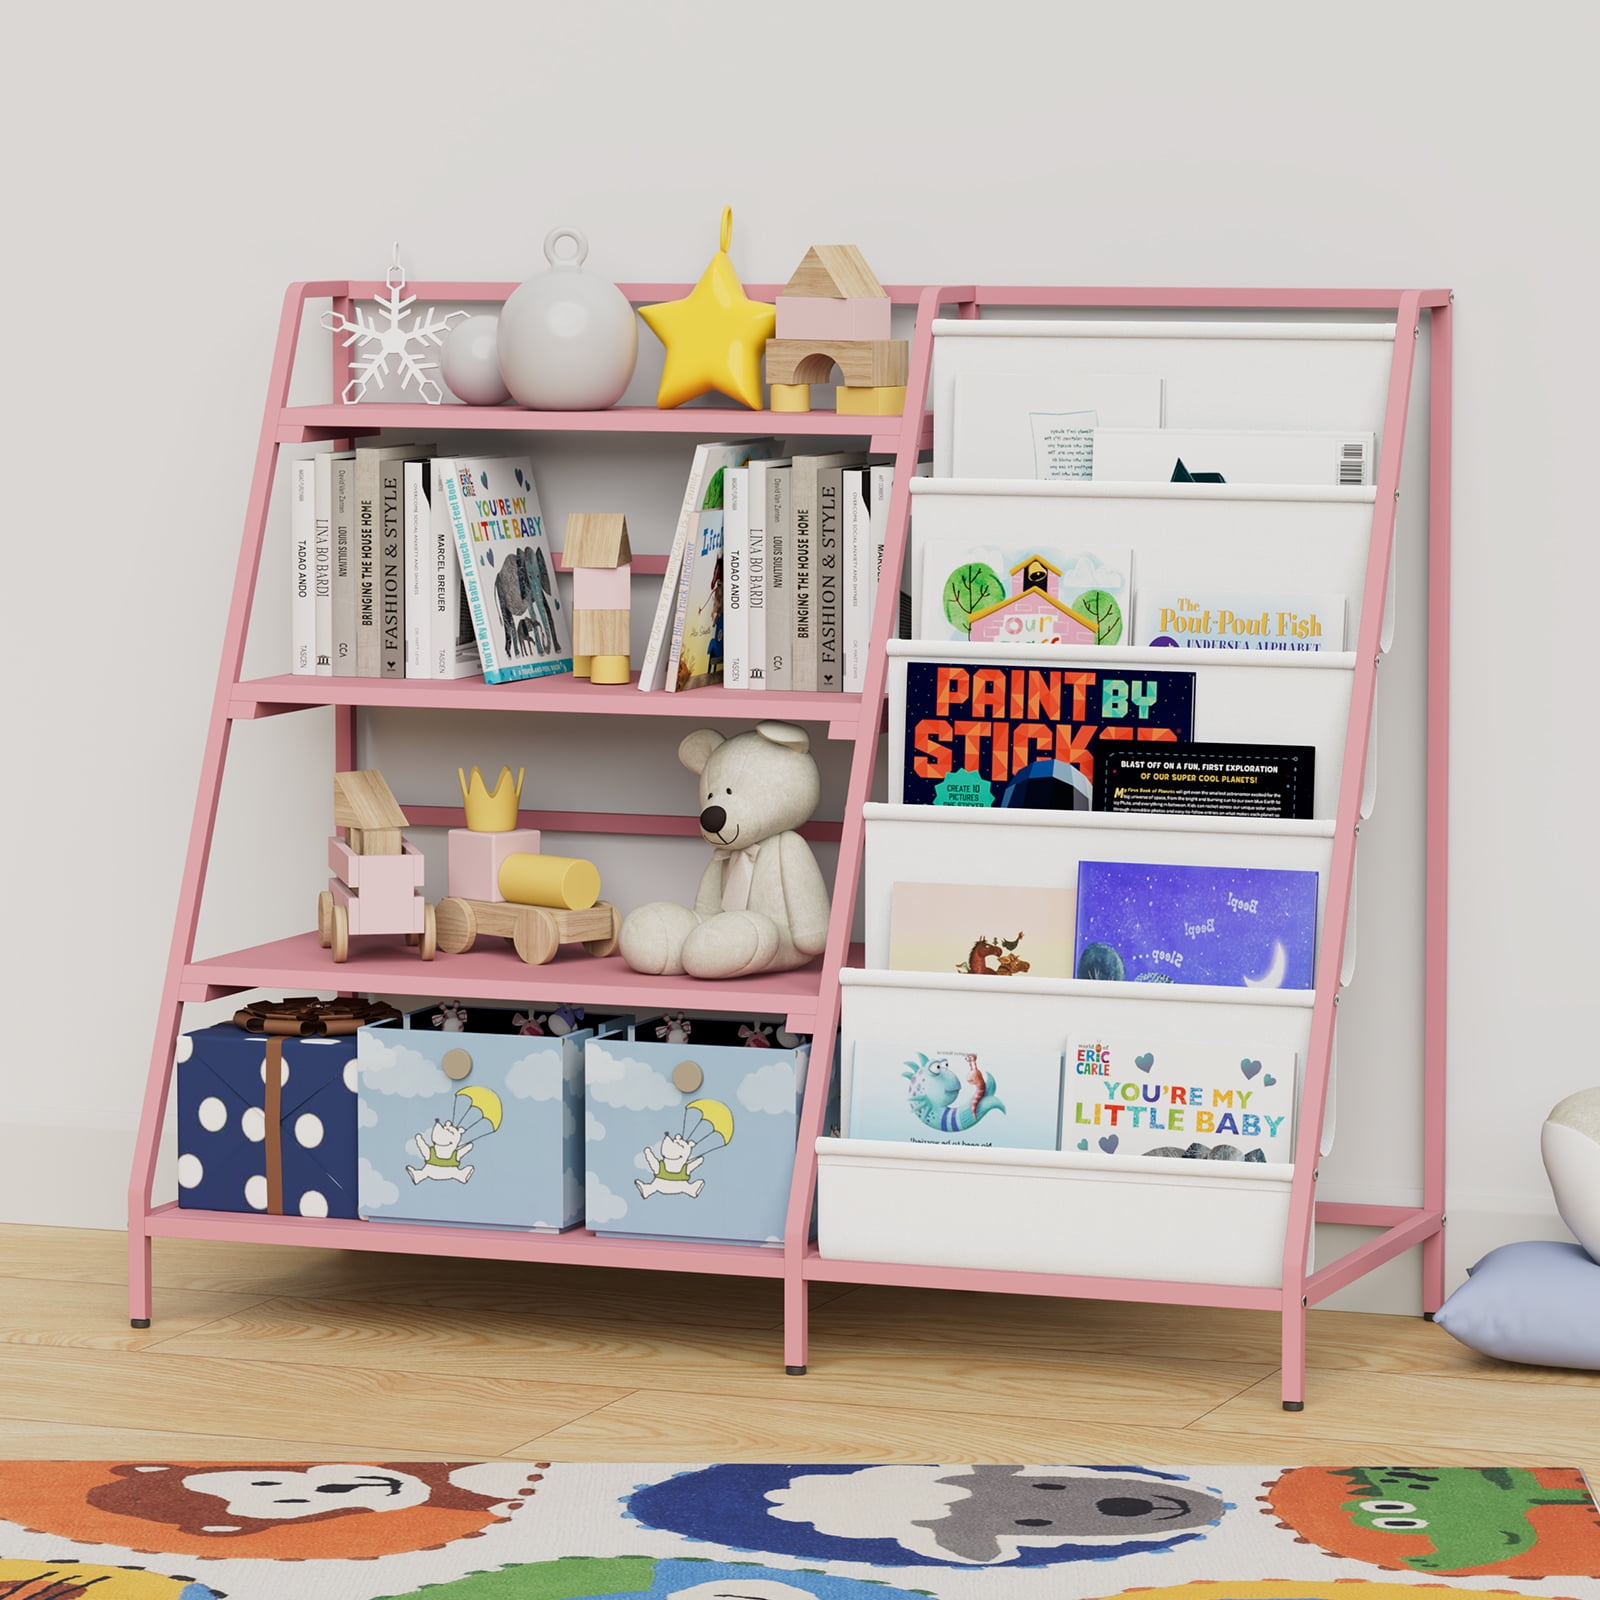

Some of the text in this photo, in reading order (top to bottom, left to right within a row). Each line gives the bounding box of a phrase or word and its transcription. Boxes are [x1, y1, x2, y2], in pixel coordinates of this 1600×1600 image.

[445, 478, 457, 501] Book
[476, 497, 526, 517] YOU'RE MY
[471, 516, 541, 542] LITTLE BABY
[701, 527, 724, 556] Littl
[316, 520, 329, 597] LINA BO BARDI
[338, 526, 348, 577] LOUIS SULLIVAN
[362, 501, 372, 625] BRINGING THE HOUSE HOME
[384, 478, 398, 649] FASHION & STYLE
[680, 542, 694, 586] Hardcover
[773, 536, 782, 588] LOUIS SULLIVAN
[298, 540, 306, 598] TADAO ANDO
[731, 550, 740, 609] TADAO ANDO
[750, 529, 763, 608] LINA BO BARDI
[798, 510, 808, 638] BRINGING THE HOUSE HOME
[822, 487, 835, 662] FASHION & STYLE
[676, 590, 688, 613] Truck
[1178, 598, 1200, 612] The
[673, 617, 684, 636] Blue
[1158, 608, 1322, 639] Pout-Pout Fish
[936, 667, 1158, 721] PAINT BY
[914, 719, 1178, 784] STICK
[1121, 760, 1145, 768] BLAST
[1226, 764, 1278, 773] EXPLORATION
[947, 784, 980, 793] CREATE 10
[1172, 774, 1196, 782] SUPER
[1222, 776, 1257, 784] PLANETS!
[949, 793, 979, 801] PICTURES
[1076, 1062, 1110, 1076] CARLE
[1104, 1081, 1253, 1109] YOU'RE MY
[1075, 1102, 1285, 1138] LITTLE BABY
